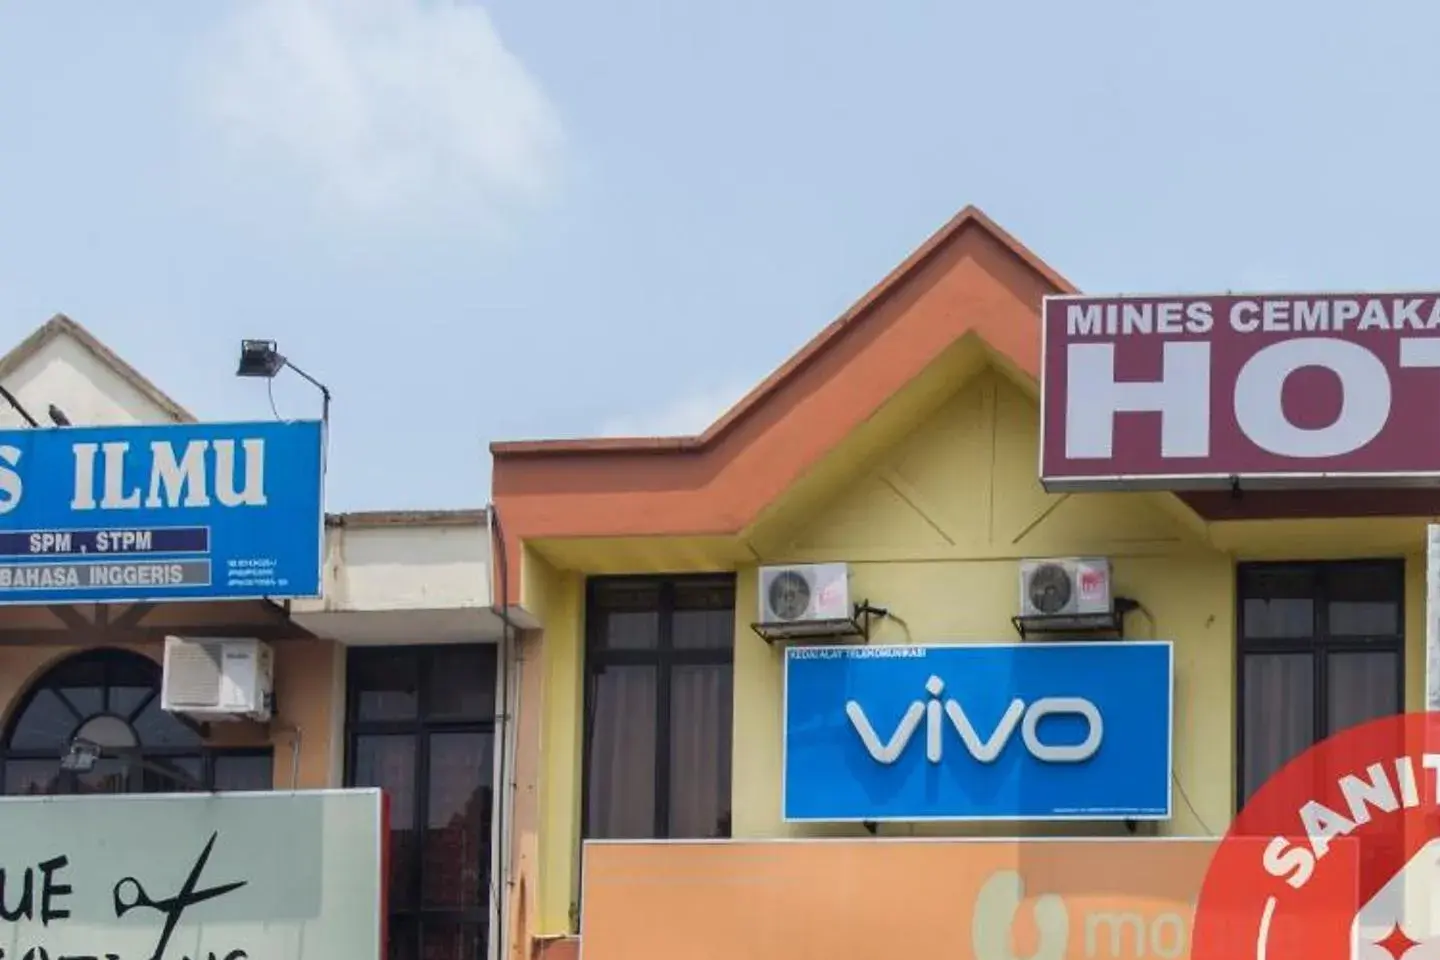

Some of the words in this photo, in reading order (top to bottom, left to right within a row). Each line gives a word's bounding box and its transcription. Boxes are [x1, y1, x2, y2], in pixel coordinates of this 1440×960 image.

[1066, 303, 1214, 335] MINES
[70, 438, 267, 511] ILMU
[29, 533, 72, 554] SPM
[96, 531, 152, 551] STPM
[0, 567, 79, 588] BAHASA
[89, 564, 183, 585] INGGERIS
[845, 674, 1104, 764] vivo
